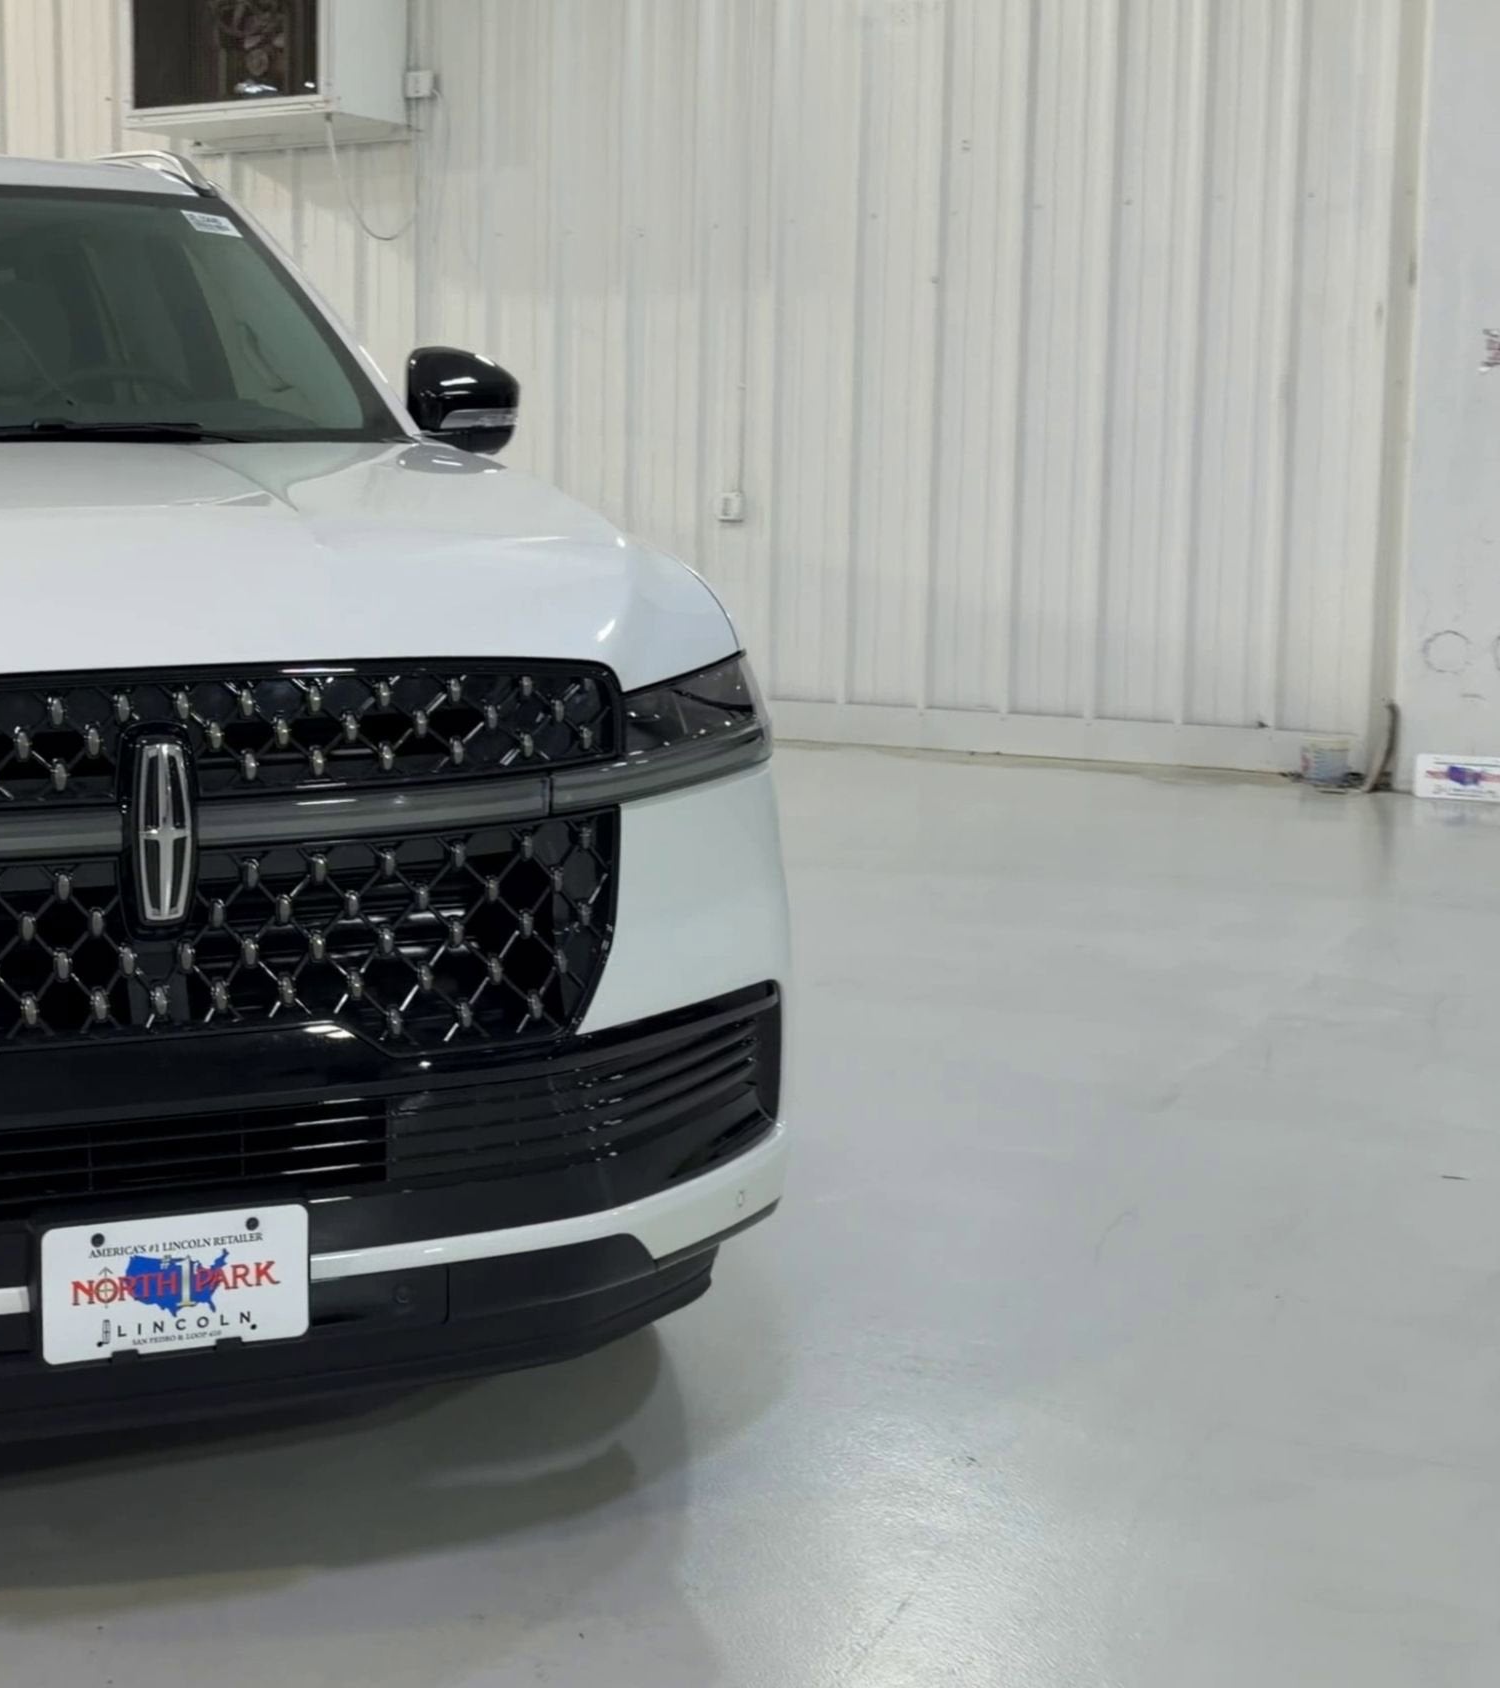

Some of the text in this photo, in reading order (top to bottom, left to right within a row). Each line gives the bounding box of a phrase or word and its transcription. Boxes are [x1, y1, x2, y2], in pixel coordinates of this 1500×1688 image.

[88, 1232, 263, 1259] AMERICA'S #1 LINCOLN RETAILER
[71, 1261, 280, 1307] NORTH PARK
[117, 1311, 251, 1338] LINCOLN
[132, 1337, 148, 1346] SAN
[149, 1334, 176, 1344] PEDRO
[185, 1331, 208, 1340] LOOP
